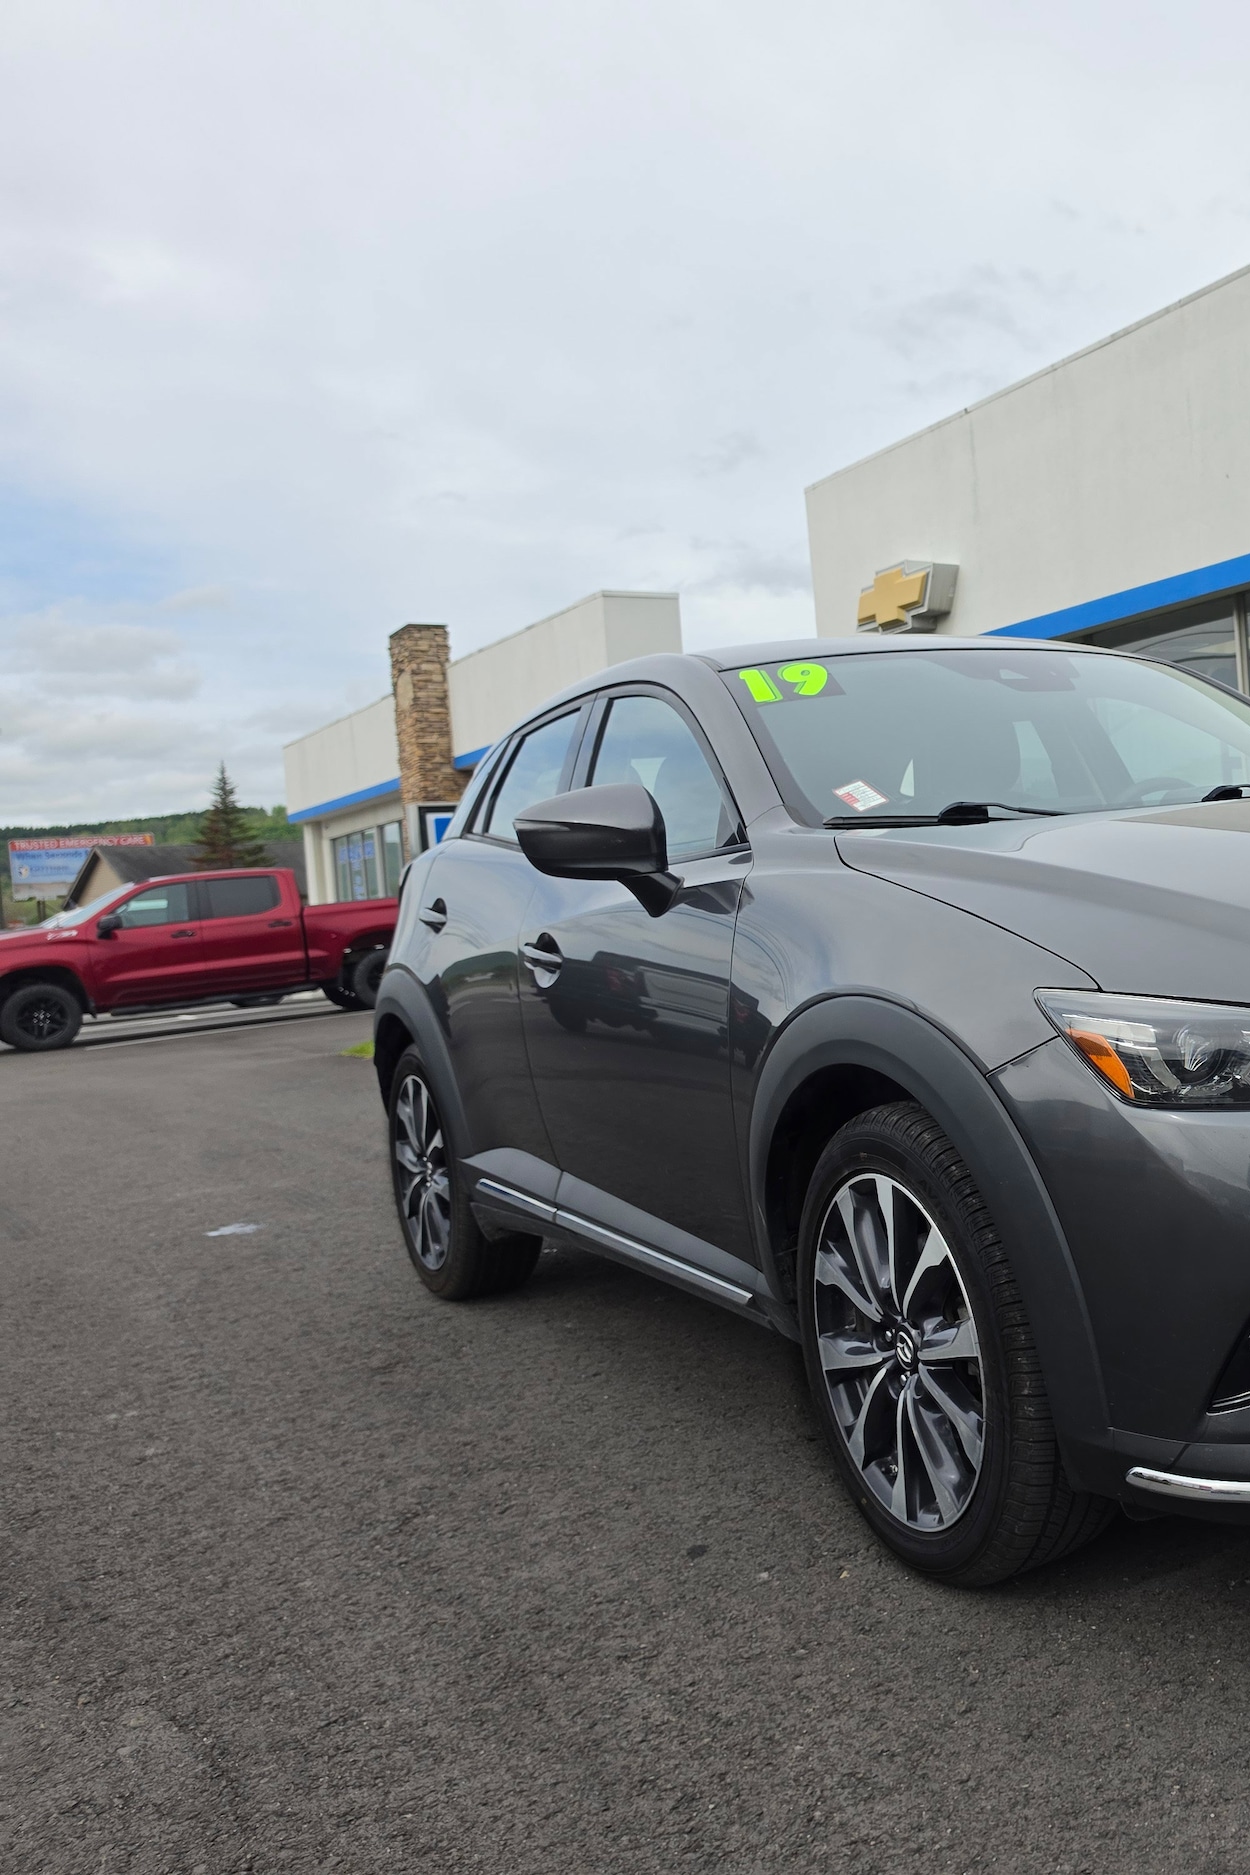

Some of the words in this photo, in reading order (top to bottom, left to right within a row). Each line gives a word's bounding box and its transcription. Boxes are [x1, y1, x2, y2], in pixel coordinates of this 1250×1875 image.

[739, 662, 828, 703] 19
[14, 839, 58, 850] TRUSTED
[59, 836, 118, 848] EMERGENCY
[120, 835, 145, 846] CARE
